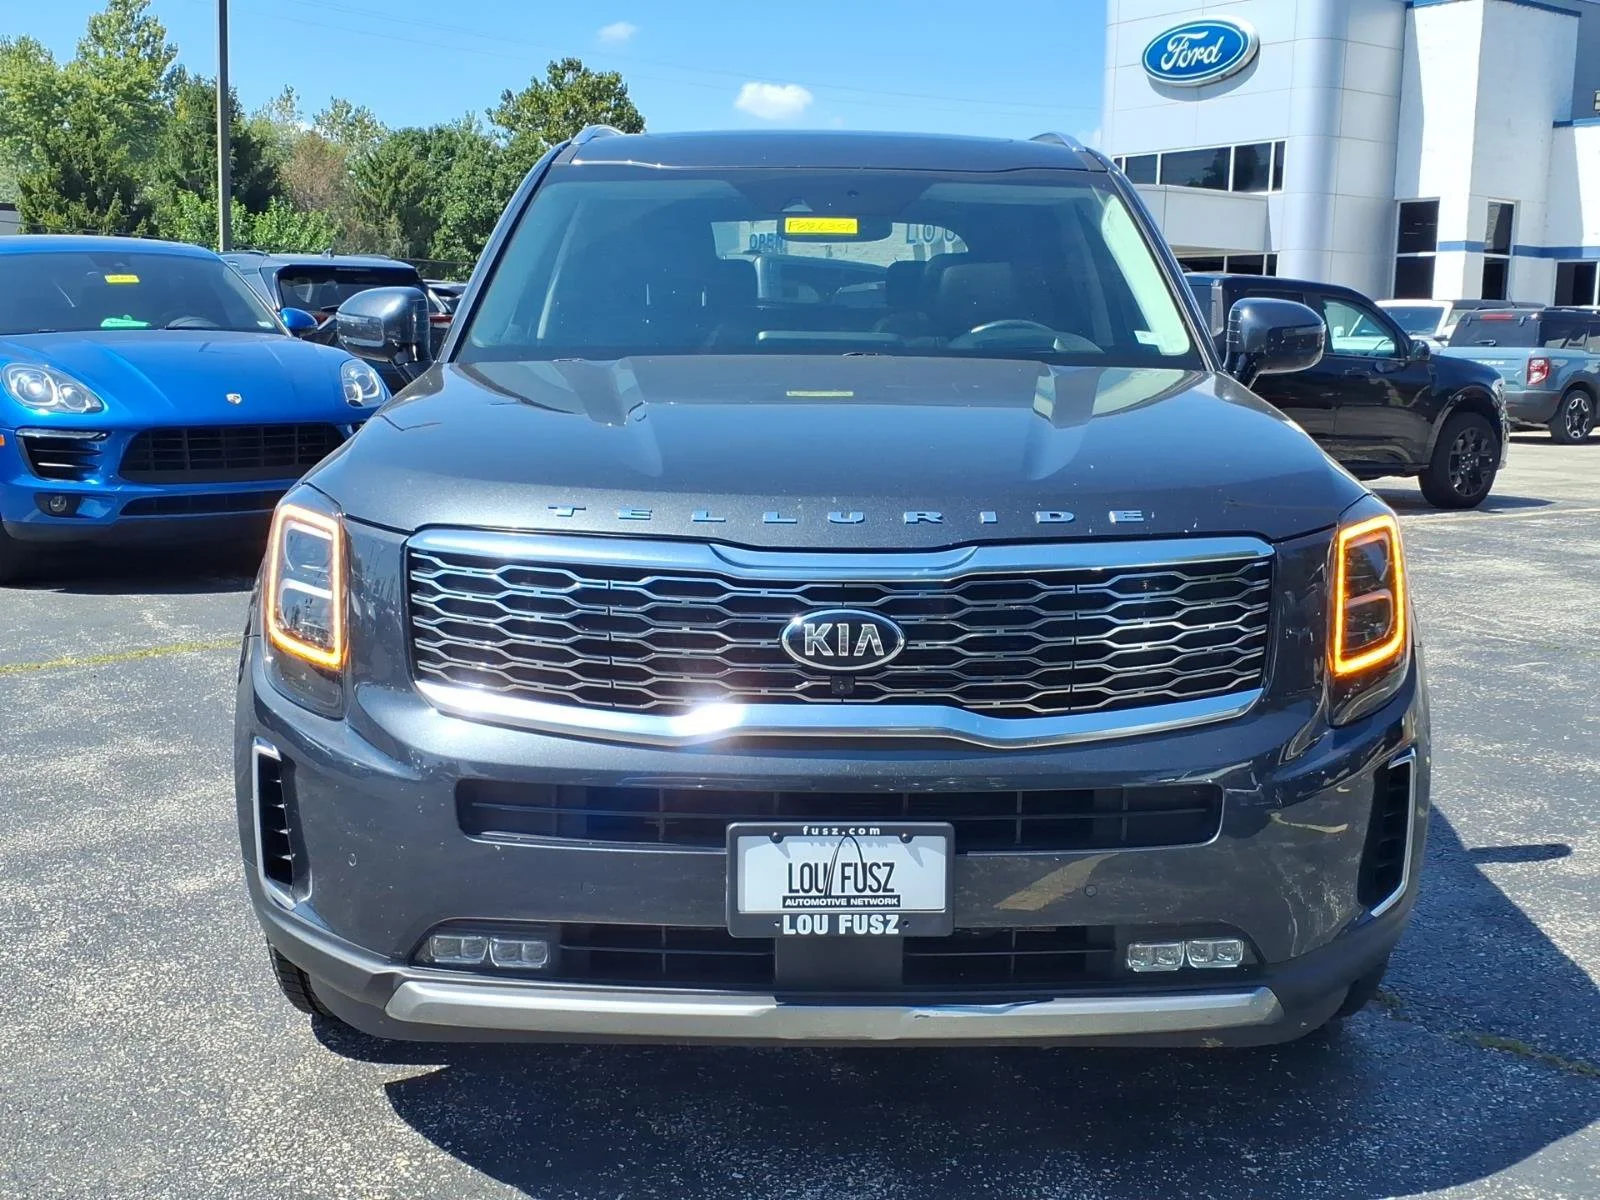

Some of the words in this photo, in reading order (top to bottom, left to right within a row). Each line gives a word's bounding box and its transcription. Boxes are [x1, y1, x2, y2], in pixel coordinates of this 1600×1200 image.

[1160, 31, 1225, 71] Ford
[548, 505, 1145, 524] TELLURIDE
[803, 622, 885, 657] KIA
[802, 825, 881, 836] fusz.com
[787, 862, 829, 894] LOU
[840, 862, 895, 894] FUSZ
[785, 897, 847, 907] AUTOMOTIVE
[850, 897, 899, 907] NETWORK
[783, 914, 829, 935] LOU
[838, 914, 900, 935] FUSZ
